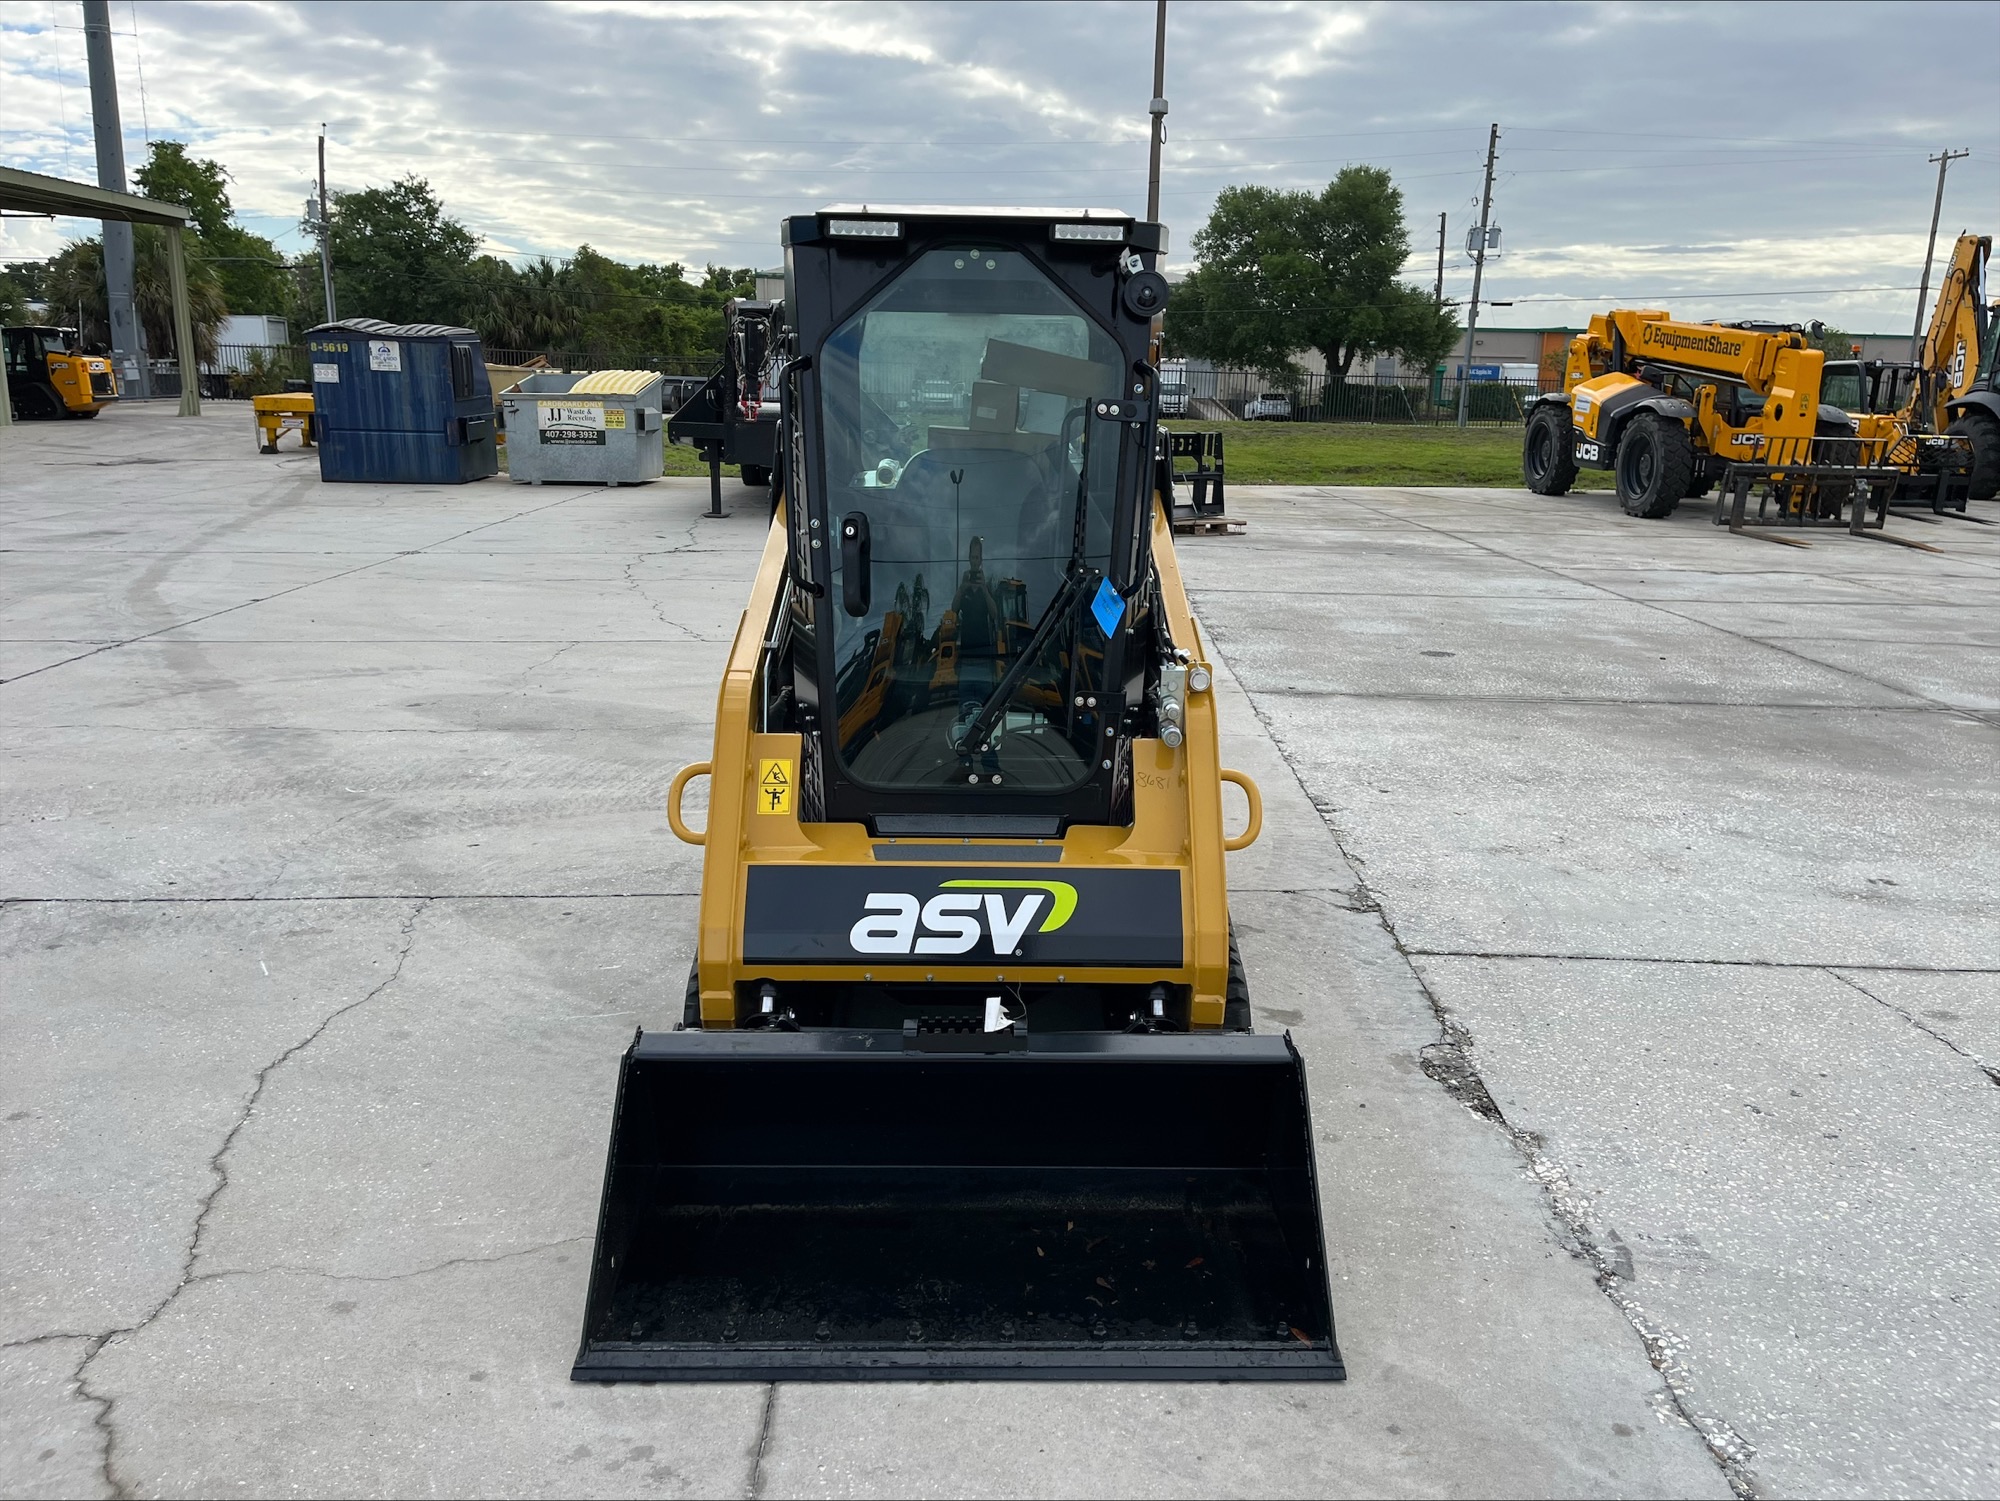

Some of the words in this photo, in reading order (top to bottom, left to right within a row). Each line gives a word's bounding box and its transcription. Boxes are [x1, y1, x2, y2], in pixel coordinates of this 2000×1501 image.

[1653, 327, 1742, 357] EquipmentShare
[90, 362, 105, 370] JCB
[1954, 342, 1966, 389] JCB
[538, 400, 581, 408] CARDBOARD
[545, 430, 598, 439] 407-298-3932
[1926, 438, 1945, 446] JCB
[1575, 443, 1599, 461] JCB
